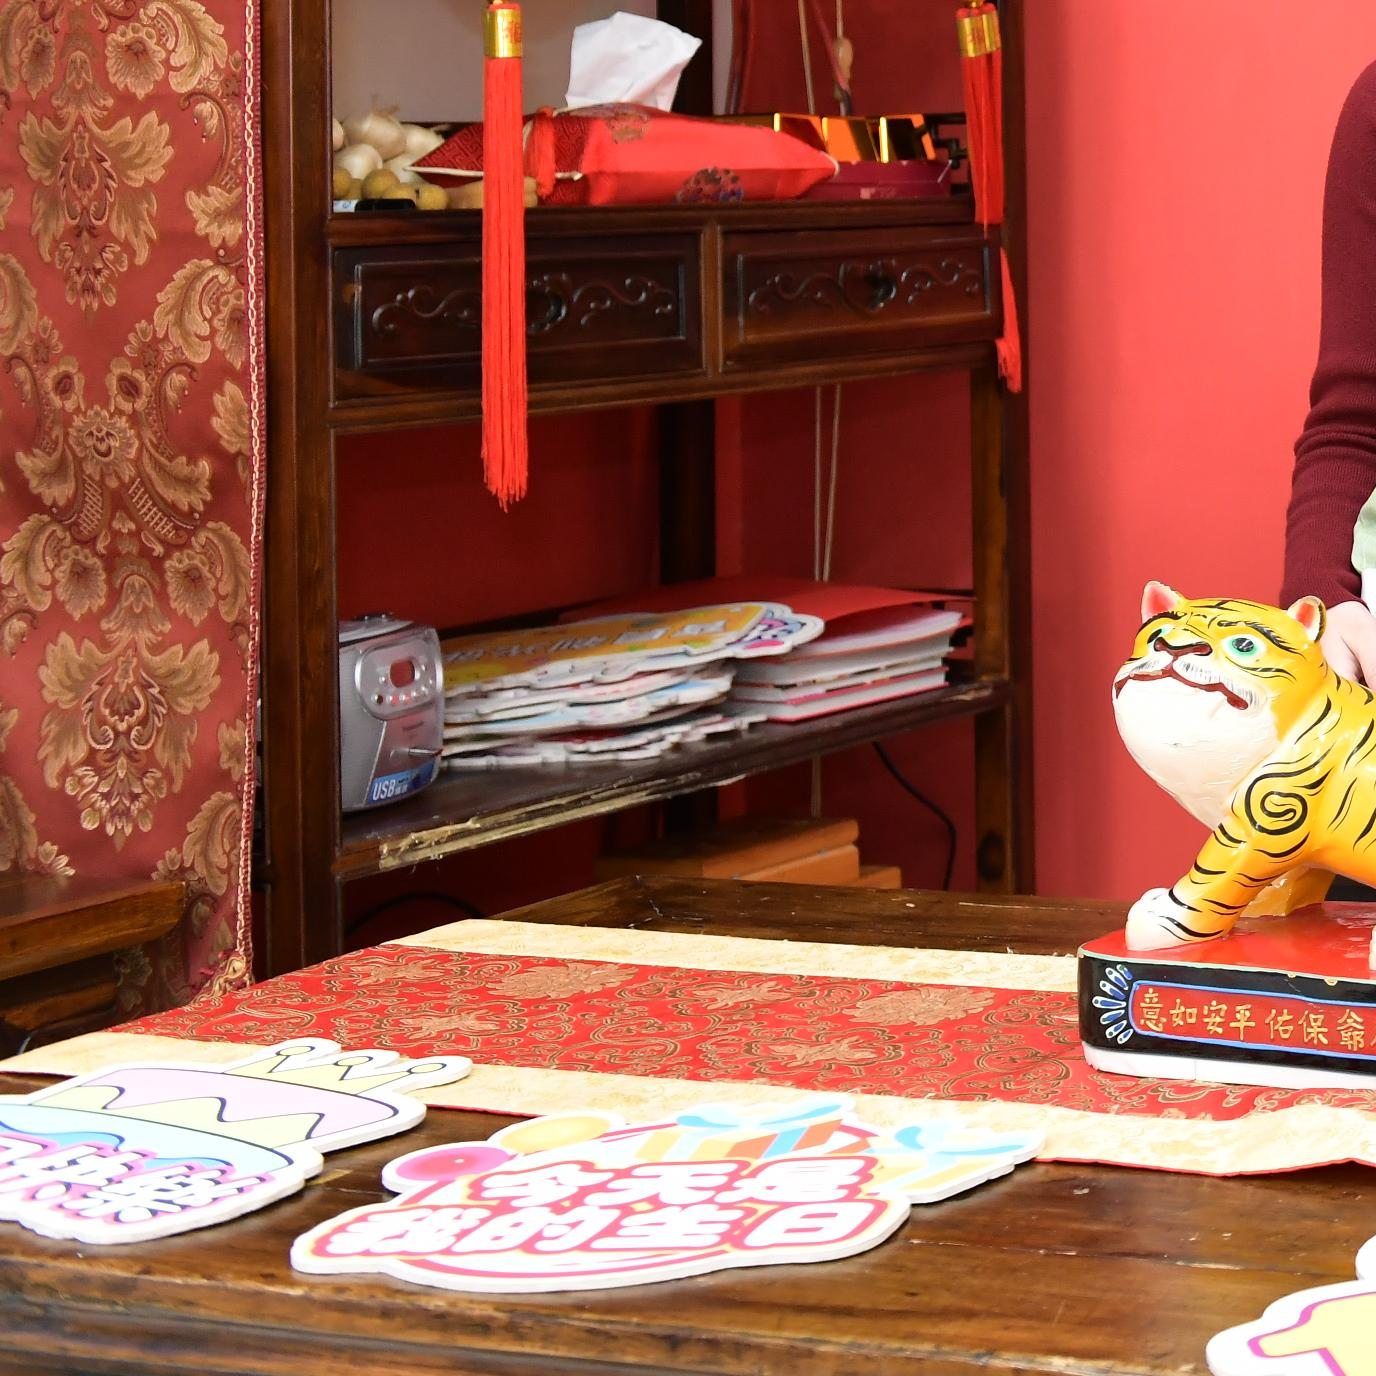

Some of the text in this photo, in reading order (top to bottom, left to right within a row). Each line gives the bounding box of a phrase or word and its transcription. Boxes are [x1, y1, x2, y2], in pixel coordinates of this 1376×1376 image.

[372, 779, 396, 801] USB
[480, 1158, 866, 1206] 今天是
[328, 1201, 886, 1256] 我的生日
